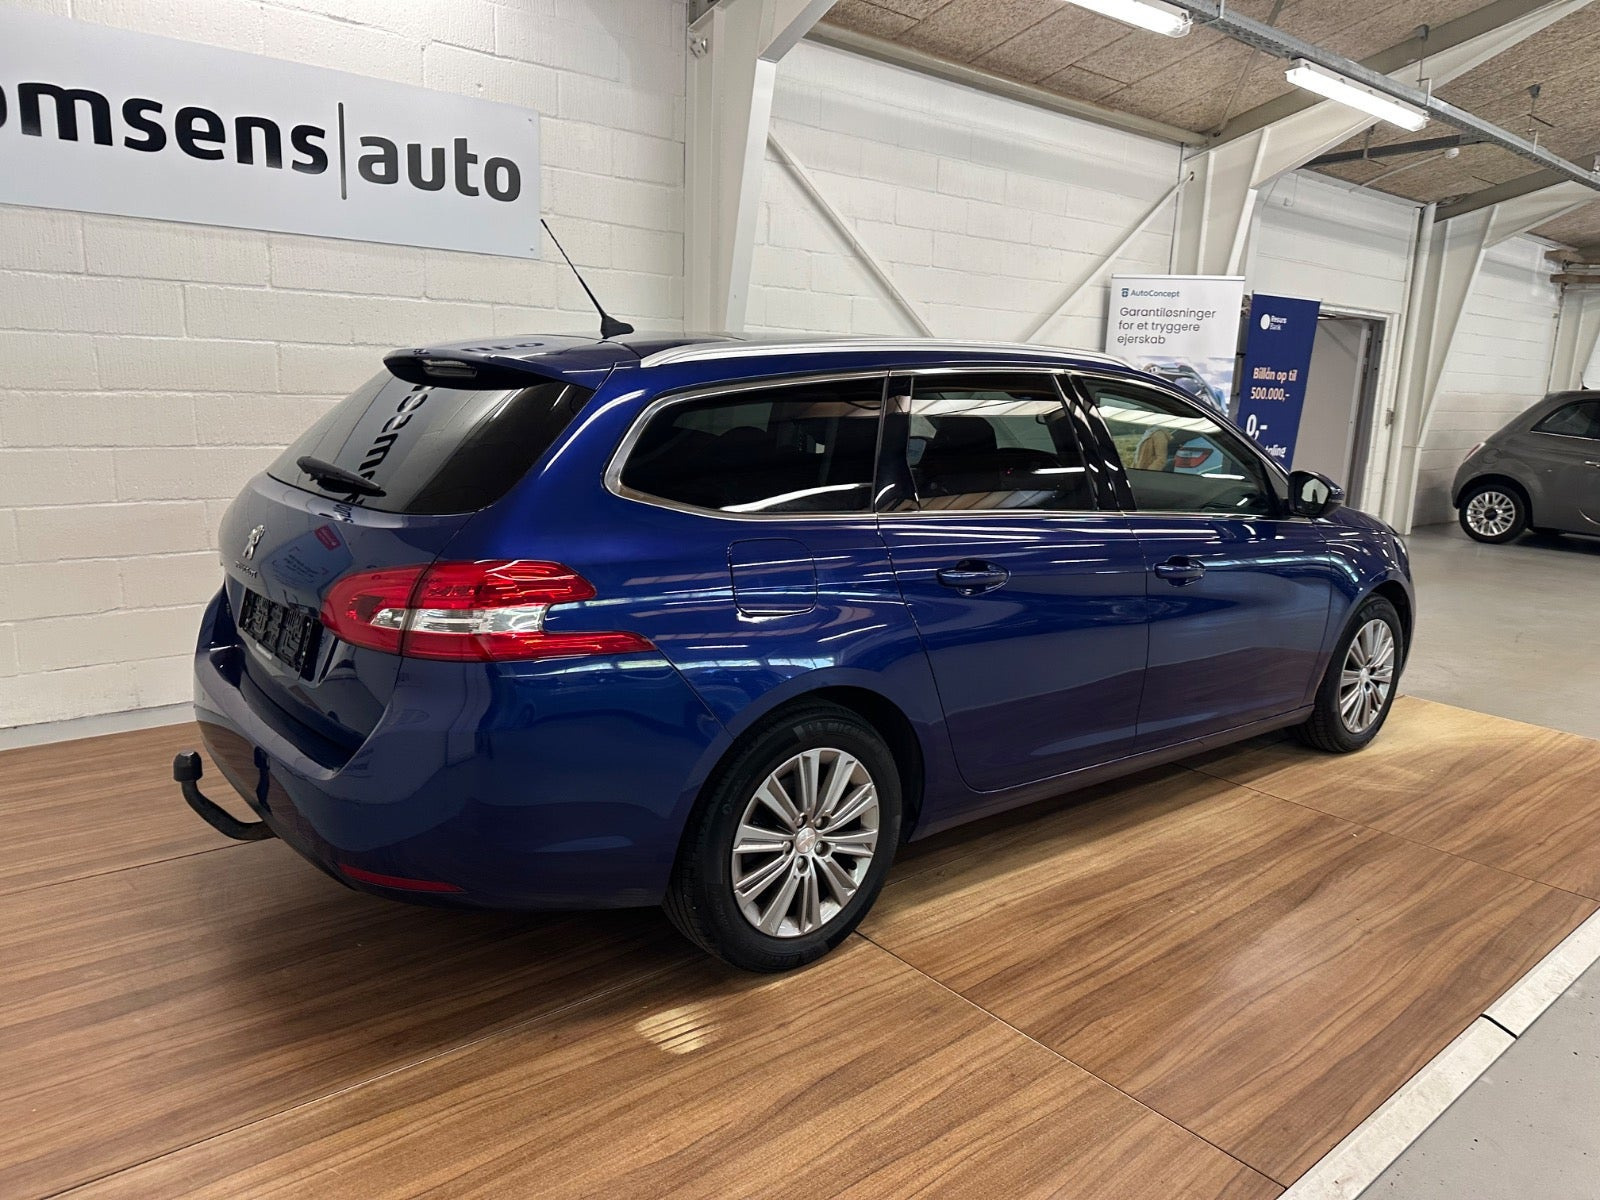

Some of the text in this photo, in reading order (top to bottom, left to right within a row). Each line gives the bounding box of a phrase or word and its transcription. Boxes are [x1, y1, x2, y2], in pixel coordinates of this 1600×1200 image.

[0, 82, 522, 203] msens auto
[1130, 289, 1180, 298] AutoConcept
[1119, 307, 1216, 320] Garantiløsninger
[1118, 320, 1201, 334] for et tryggere
[1117, 334, 1166, 346] ejerskab
[1276, 371, 1287, 384] op
